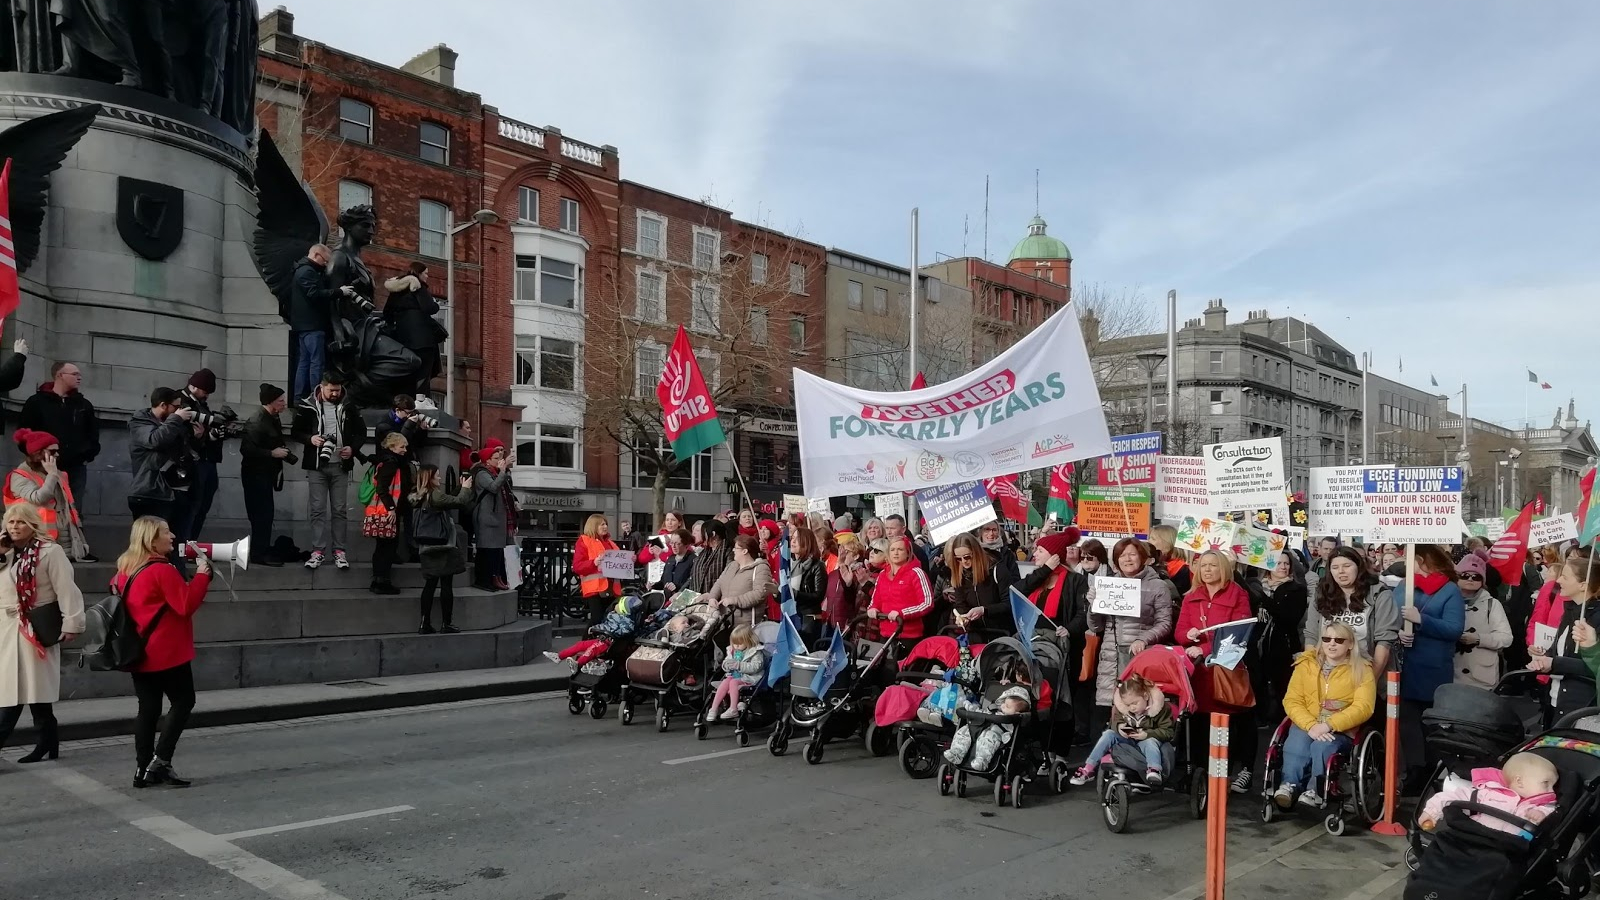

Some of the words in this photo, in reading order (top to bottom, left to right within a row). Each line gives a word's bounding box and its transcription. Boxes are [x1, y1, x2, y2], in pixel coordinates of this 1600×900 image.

[866, 374, 1013, 421] TOGETHER
[881, 412, 968, 440] EARLY
[974, 371, 1066, 430] YEARS
[1111, 439, 1130, 453] TEACH
[1131, 436, 1160, 451] RESPECT
[1212, 445, 1272, 461] Consultation
[920, 458, 935, 468] Big
[1102, 456, 1125, 470] NOW
[1127, 452, 1157, 468] SHOW
[1159, 457, 1206, 466] UNDERGRADUAT
[920, 467, 941, 476] Start
[1107, 470, 1121, 482] US
[1123, 467, 1151, 481] SOME
[1368, 469, 1396, 481] ECCE
[1398, 468, 1444, 480] FUNDING
[1447, 467, 1458, 480] IS
[839, 475, 875, 483] Childhood
[1376, 481, 1395, 492] FAR
[1397, 480, 1418, 492] TOO
[1420, 480, 1443, 492] LOW
[921, 486, 938, 499] YOU
[923, 488, 959, 509] CHILDREN
[959, 480, 980, 495] FIRST
[935, 505, 944, 515] IF
[944, 498, 959, 511] YOU
[960, 492, 974, 504] PUT
[1158, 495, 1178, 503] UNDER
[1180, 496, 1191, 504] THE
[1364, 495, 1398, 503] WITHOUT
[1400, 494, 1417, 503] OUR
[1419, 494, 1460, 504] SCHOOLS,
[928, 504, 970, 528] EDUCATORS
[970, 496, 988, 510] LAST
[1370, 506, 1410, 515] CHILDREN
[1412, 506, 1432, 514] WILL
[1434, 506, 1456, 514] HAVE
[1378, 517, 1389, 526] NO
[1392, 517, 1420, 525] WHERE
[1422, 517, 1433, 525] TO
[1435, 517, 1447, 525] GO
[1542, 518, 1565, 528] Teach,
[1546, 526, 1565, 534] Care,
[1548, 533, 1565, 542] Fair!
[604, 561, 633, 570] TEACHERS
[1108, 591, 1125, 600] Fund
[1098, 600, 1112, 609] Our
[1112, 600, 1135, 611] Sector
